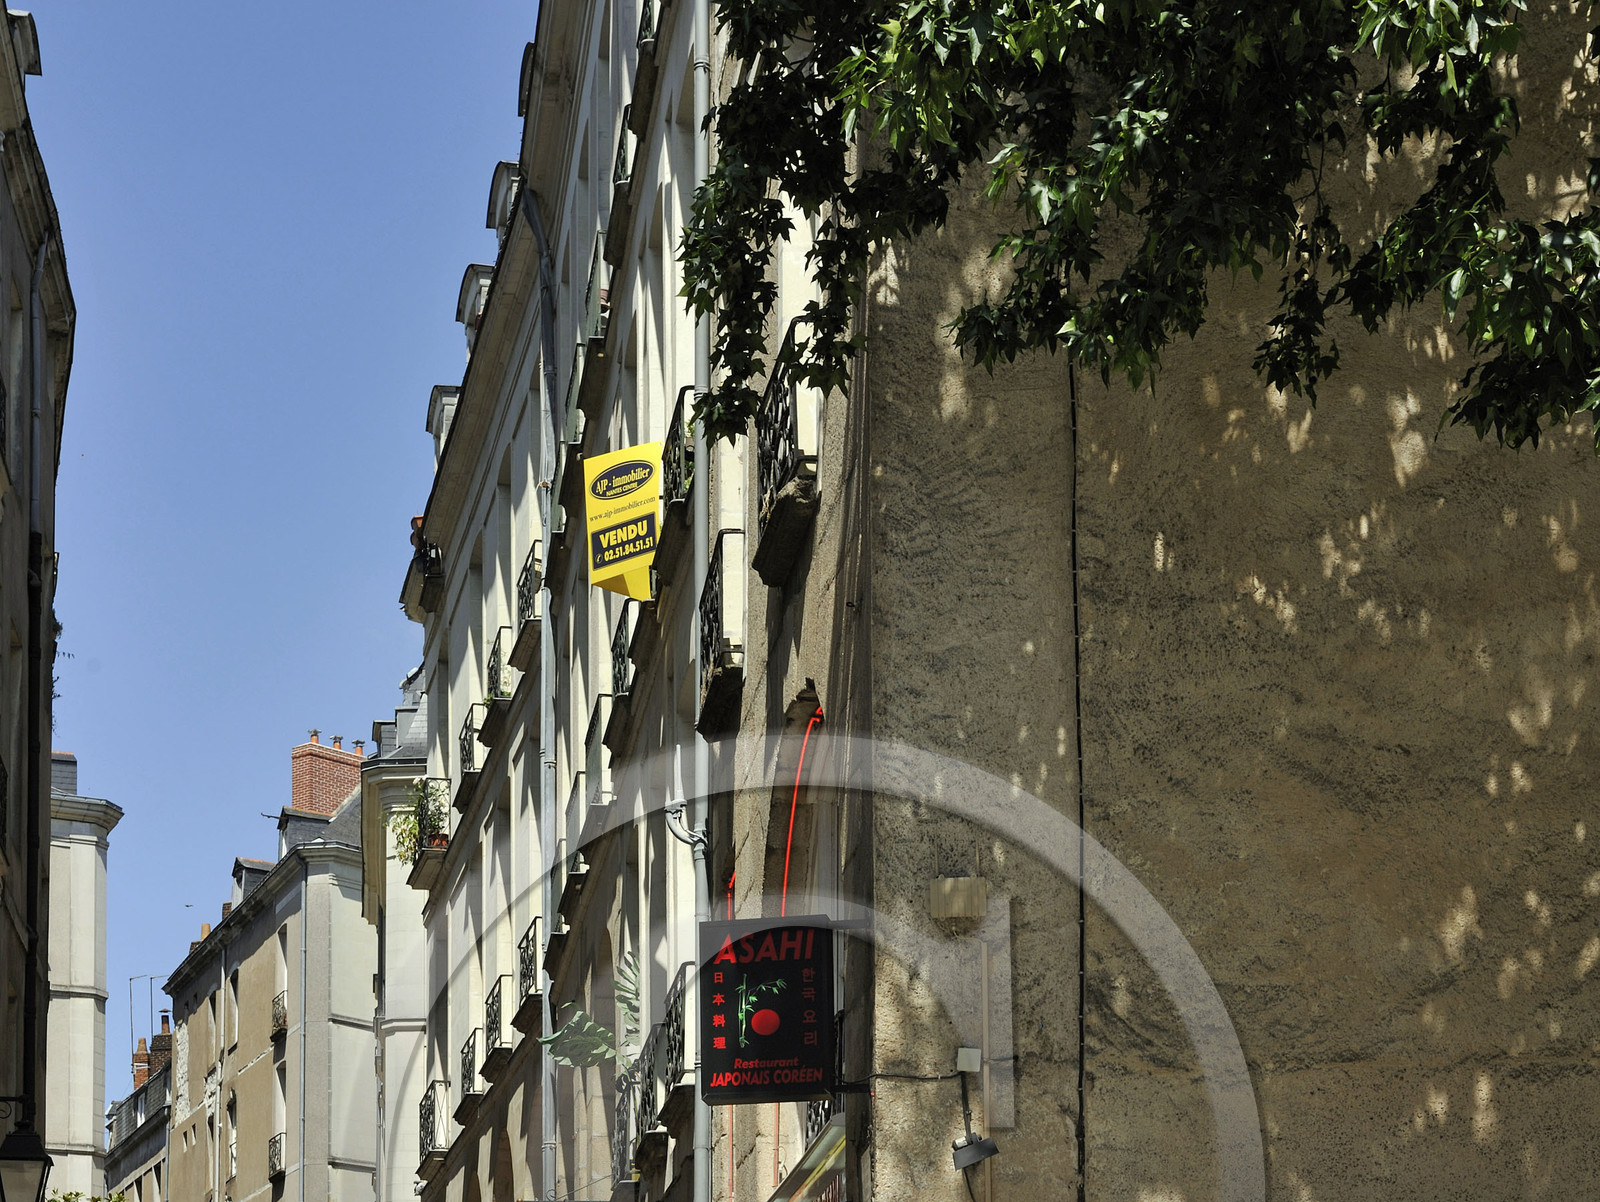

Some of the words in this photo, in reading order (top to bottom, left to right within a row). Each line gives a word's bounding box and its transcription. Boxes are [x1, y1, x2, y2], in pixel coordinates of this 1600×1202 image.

[596, 479, 608, 494] AJP
[612, 467, 650, 487] immobilier
[606, 486, 622, 496] NANTES
[623, 481, 638, 491] CENTRE
[590, 497, 655, 521] www.ajp-immobilier.com
[599, 520, 648, 548] VENDU
[604, 537, 653, 561] 02.51.84.51.51
[713, 928, 815, 965] ASAHI
[712, 971, 727, 1050] 日本料理
[734, 1057, 799, 1069] Restaurant
[710, 1070, 769, 1087] JAPONAIS
[773, 1065, 823, 1084] CORÉEN
